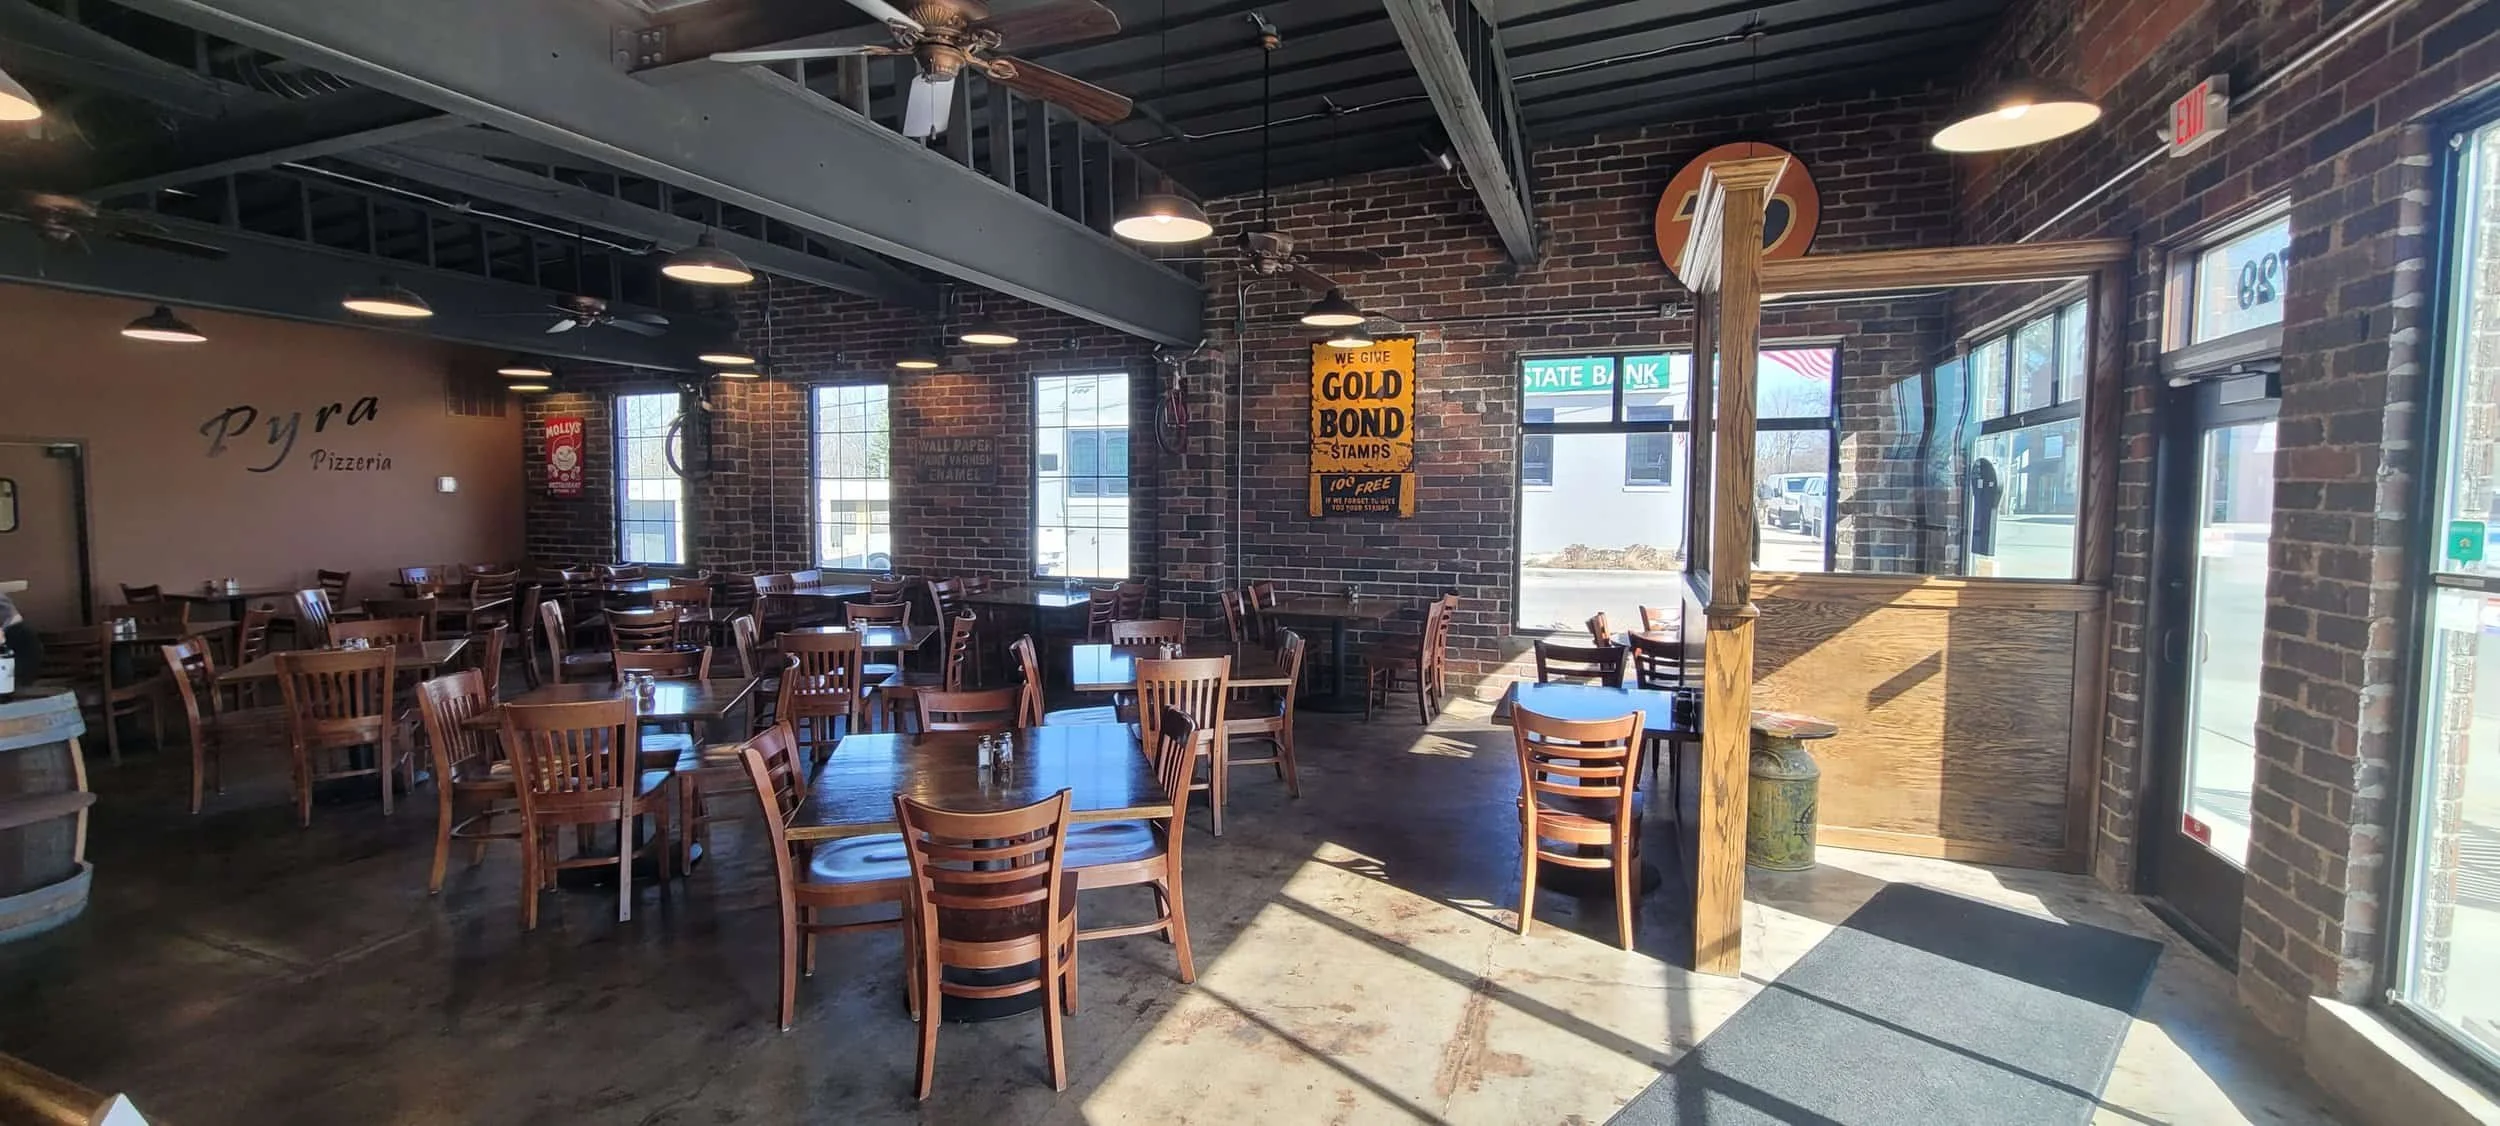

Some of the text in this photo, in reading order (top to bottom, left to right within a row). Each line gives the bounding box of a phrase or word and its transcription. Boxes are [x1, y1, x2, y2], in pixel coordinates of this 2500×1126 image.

[2176, 82, 2207, 145] EXIT
[1335, 350, 1390, 364] WE GIVE
[1322, 369, 1402, 401] GOLD
[1319, 407, 1405, 438] BOND
[199, 396, 379, 473] Pyra
[918, 439, 993, 452] WALL PAPER
[1331, 444, 1391, 460] STAMPS
[310, 448, 393, 471] Pizzeria
[918, 454, 993, 466] PAINT VARNISH
[929, 468, 981, 481] ENAMEL
[1330, 476, 1392, 496] 100 FREE
